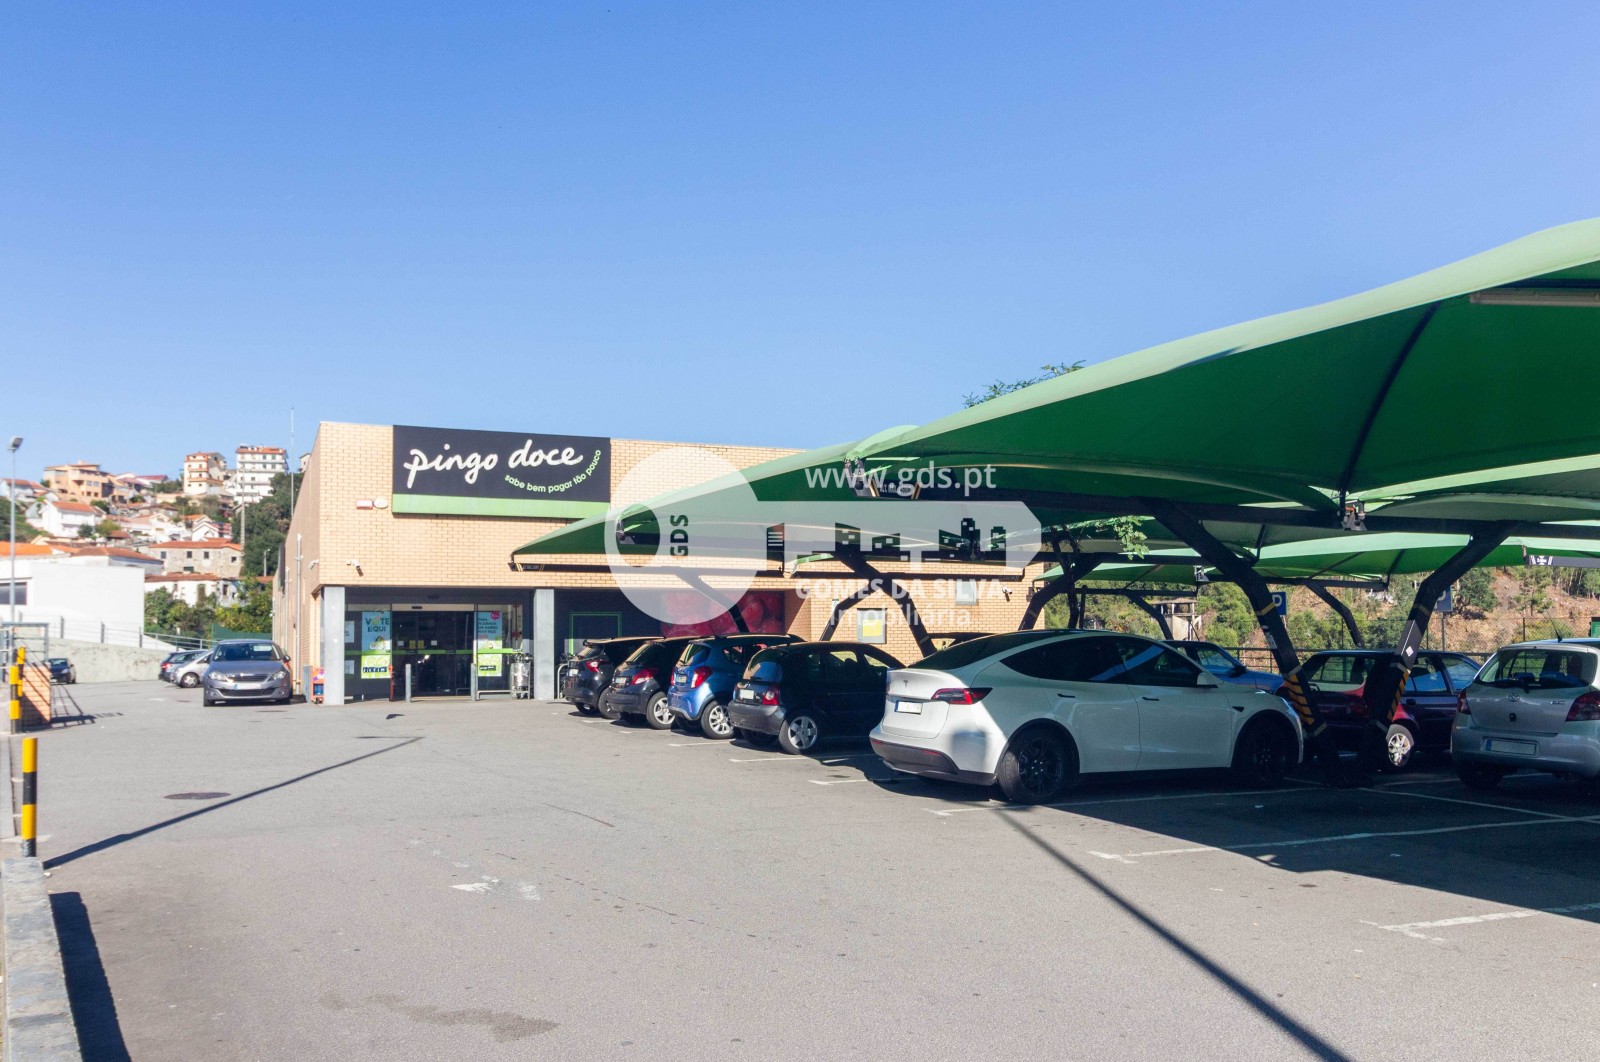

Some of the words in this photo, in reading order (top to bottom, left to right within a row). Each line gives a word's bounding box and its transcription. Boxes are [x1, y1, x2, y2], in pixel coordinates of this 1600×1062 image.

[403, 443, 498, 489] pingo
[508, 439, 583, 468] doce
[504, 474, 525, 489] sabe
[526, 482, 546, 493] bem
[548, 480, 573, 493] pagar
[573, 473, 587, 485] tão
[585, 449, 602, 477] pouco
